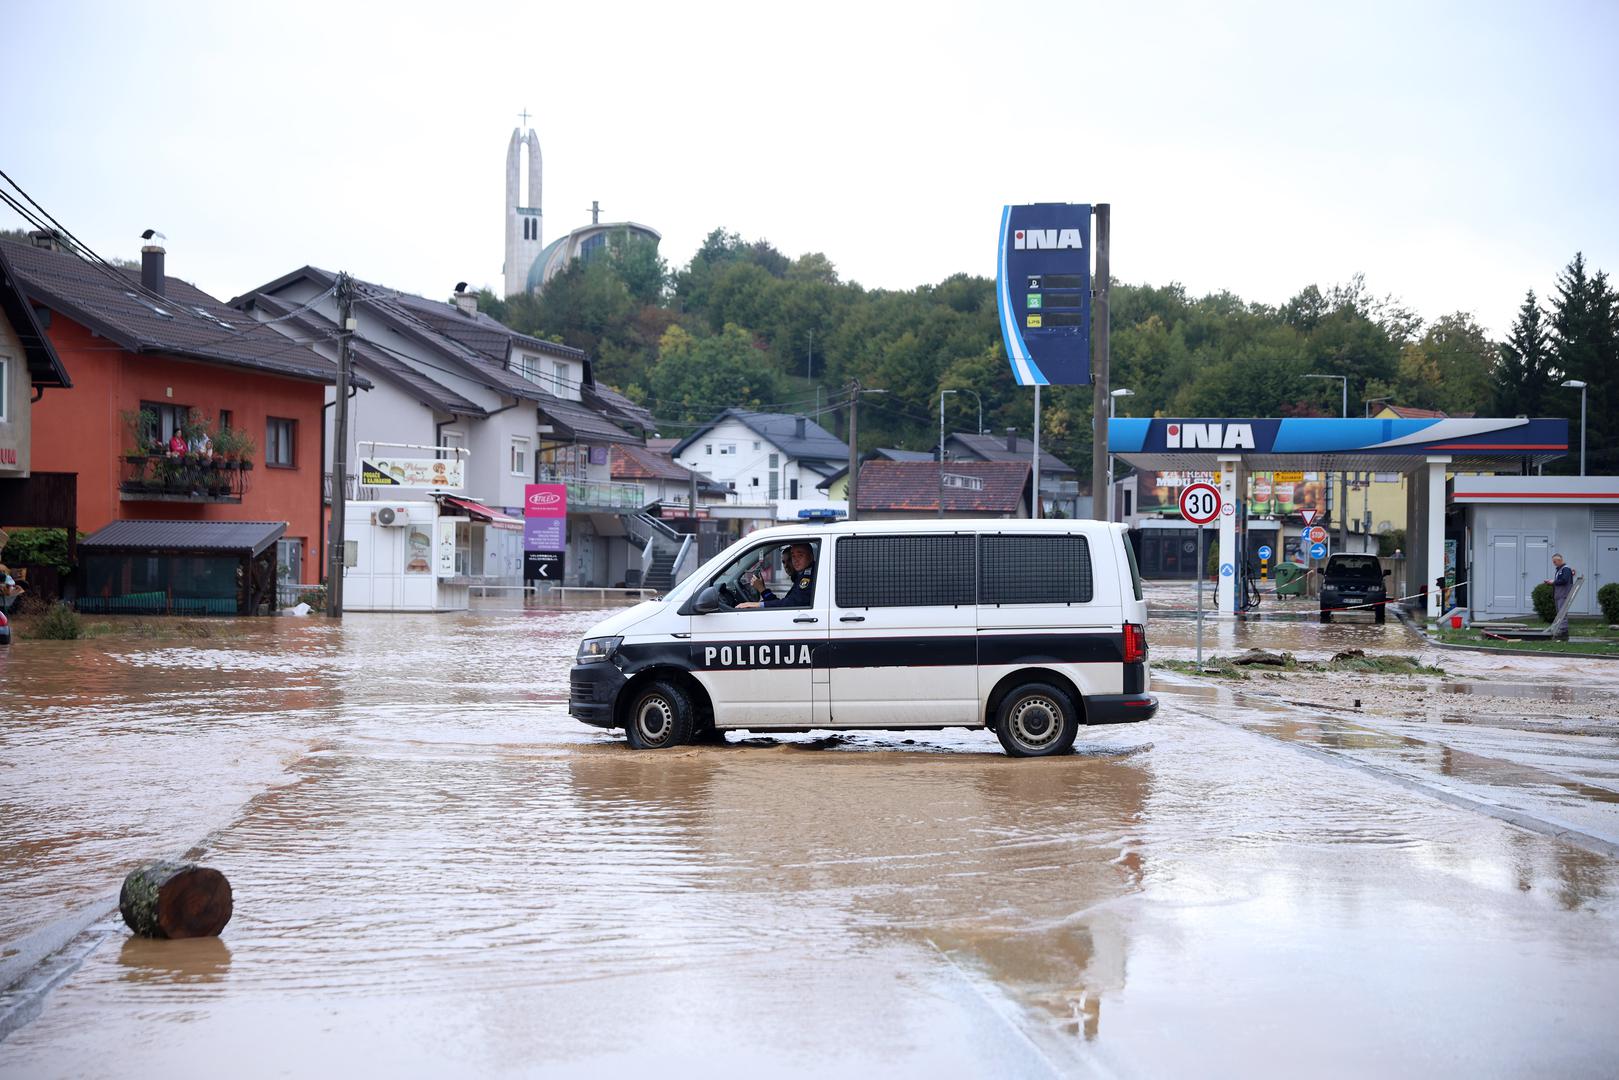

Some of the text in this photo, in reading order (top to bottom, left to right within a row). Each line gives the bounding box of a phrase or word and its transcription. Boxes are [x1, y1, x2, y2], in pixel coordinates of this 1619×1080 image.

[1014, 229, 1083, 250] INA
[1166, 423, 1256, 449] INA
[1189, 493, 1213, 514] 30
[705, 645, 811, 666] POLICIJA
